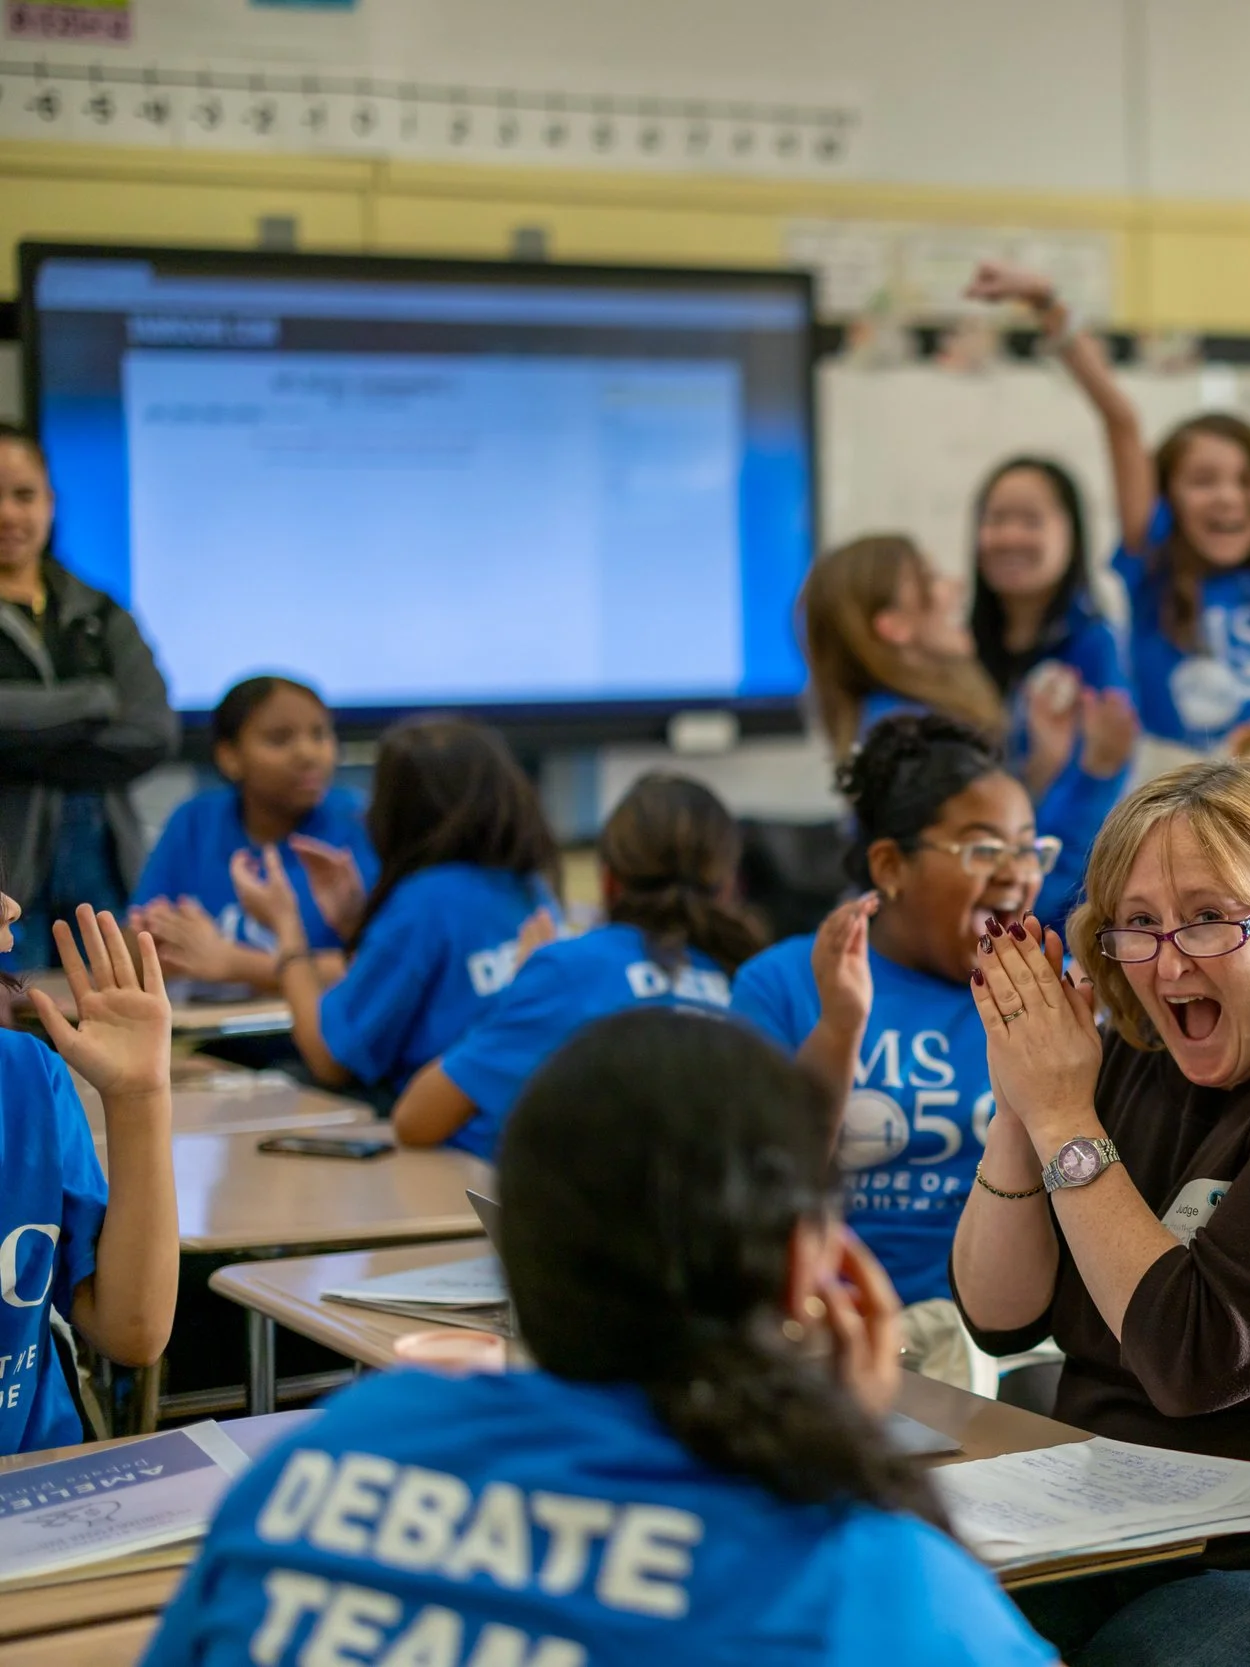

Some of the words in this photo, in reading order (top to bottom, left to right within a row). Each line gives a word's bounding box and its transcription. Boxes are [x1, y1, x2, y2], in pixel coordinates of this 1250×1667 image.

[853, 1028, 955, 1088] MS
[1176, 1205, 1199, 1217] Judge
[257, 1449, 703, 1618] DEBATE
